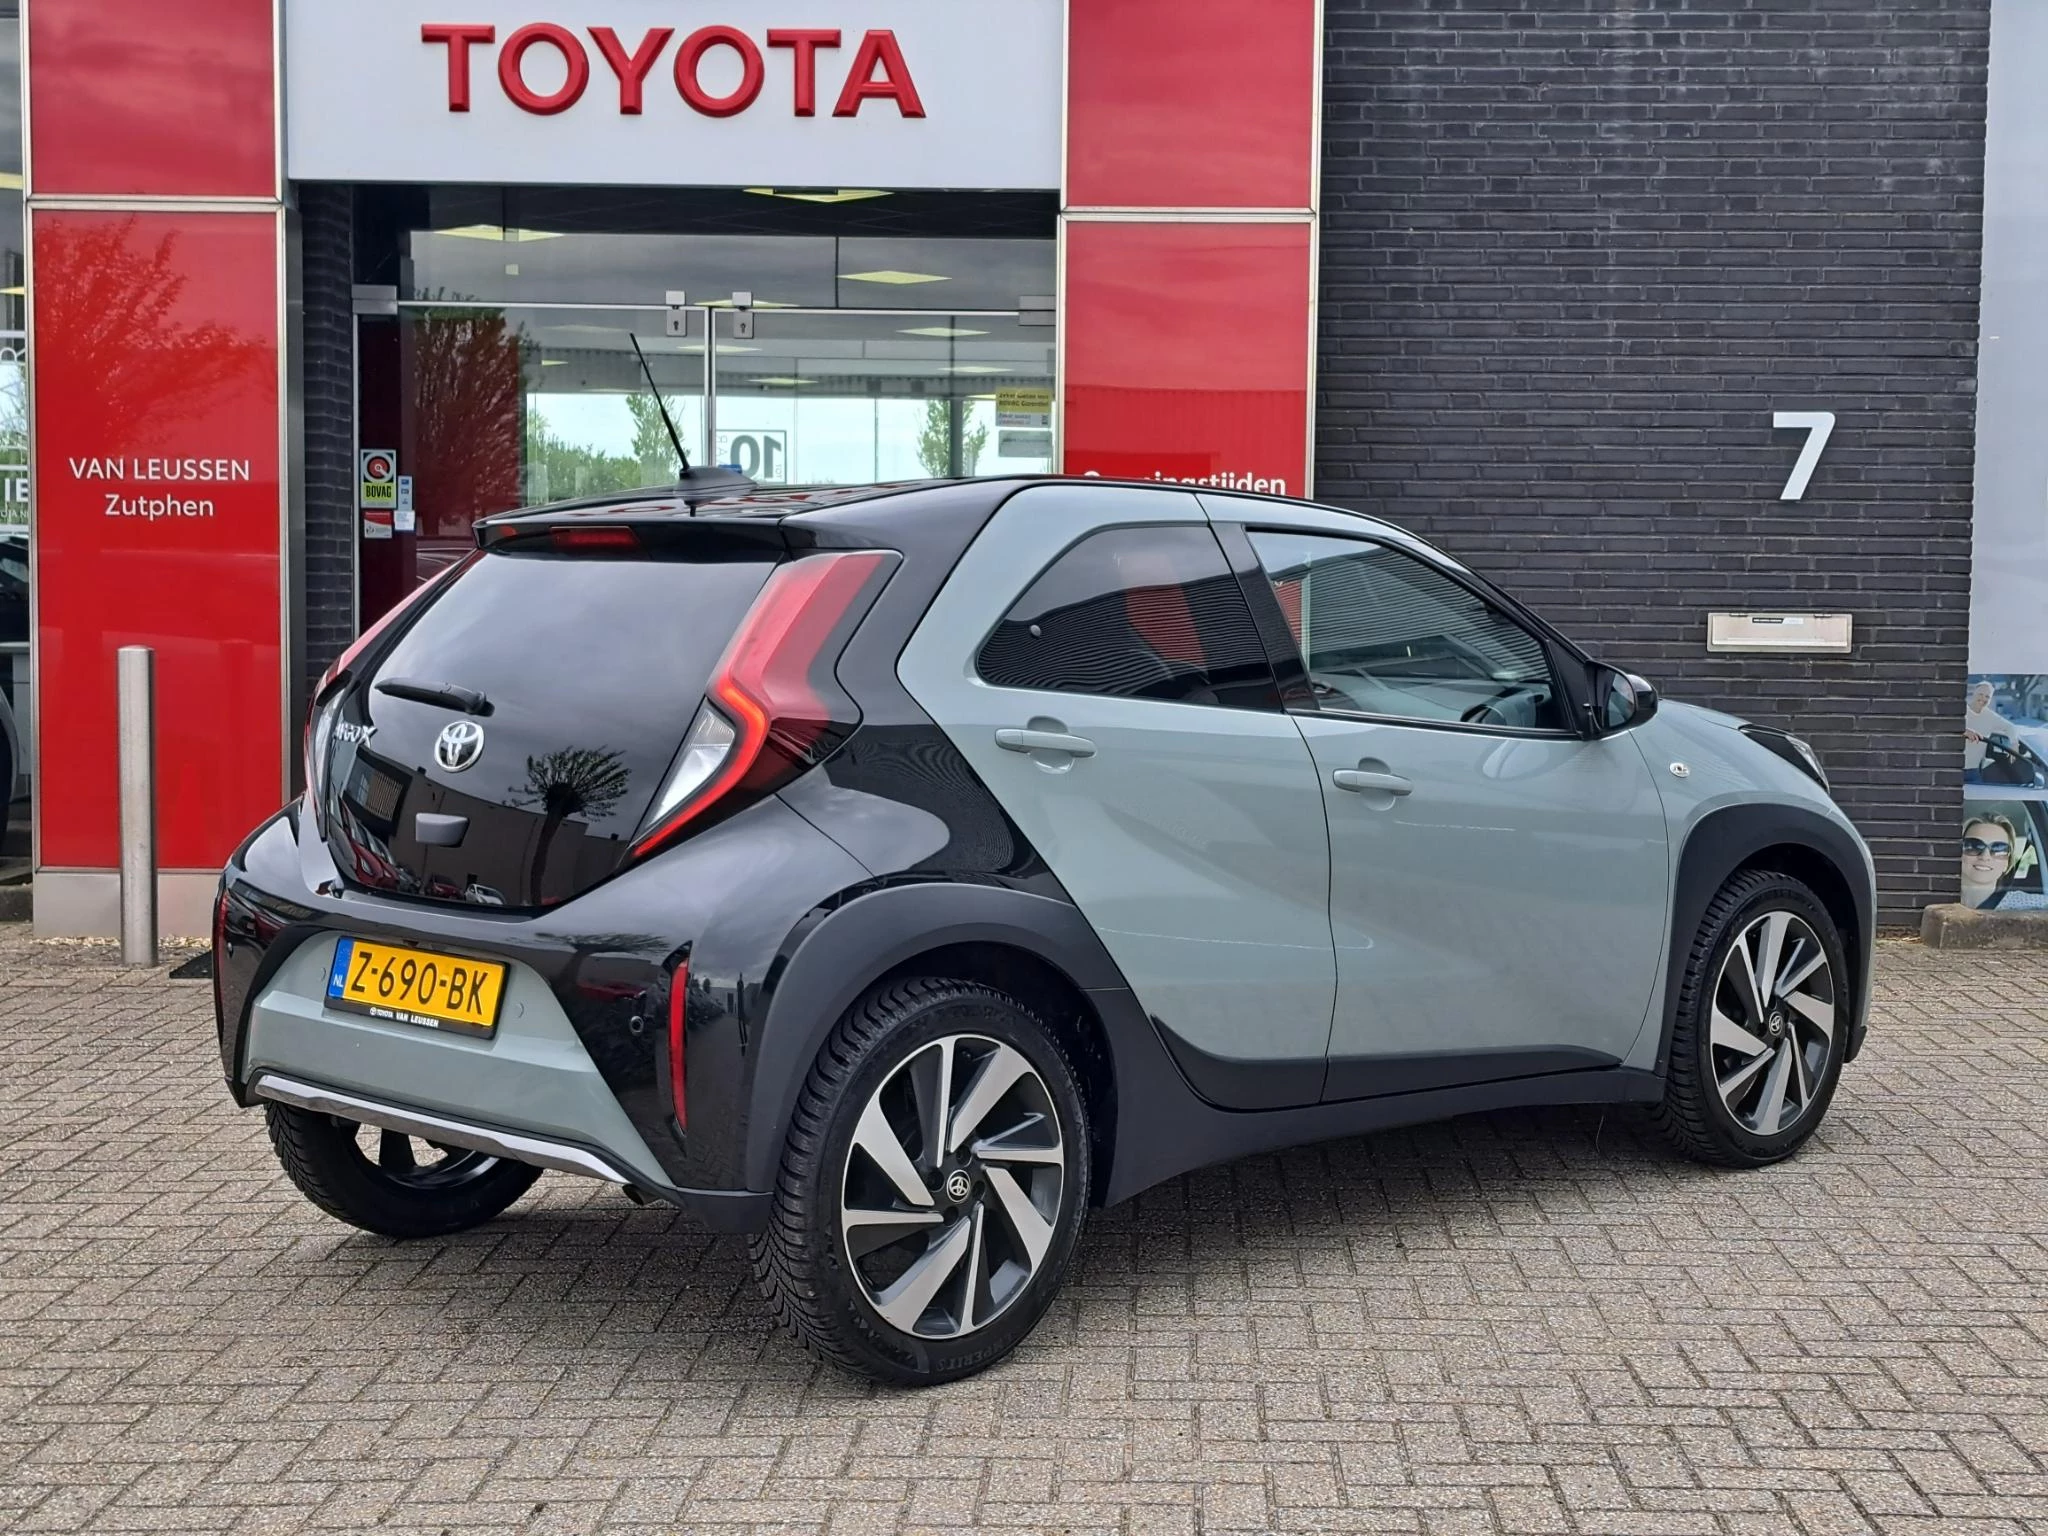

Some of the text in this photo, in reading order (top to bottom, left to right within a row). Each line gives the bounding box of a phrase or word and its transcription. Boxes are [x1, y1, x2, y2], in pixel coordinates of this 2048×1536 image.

[421, 22, 926, 118] TOYOTA
[1773, 411, 1836, 500] 7
[69, 457, 250, 481] VAN LEUSSEN
[366, 485, 391, 498] BOVAG
[105, 494, 214, 521] Zutphen
[333, 974, 344, 988] NL
[351, 950, 488, 1015] Z-690-BK
[396, 1011, 409, 1022] VAN
[410, 1014, 439, 1028] LEUSSEN
